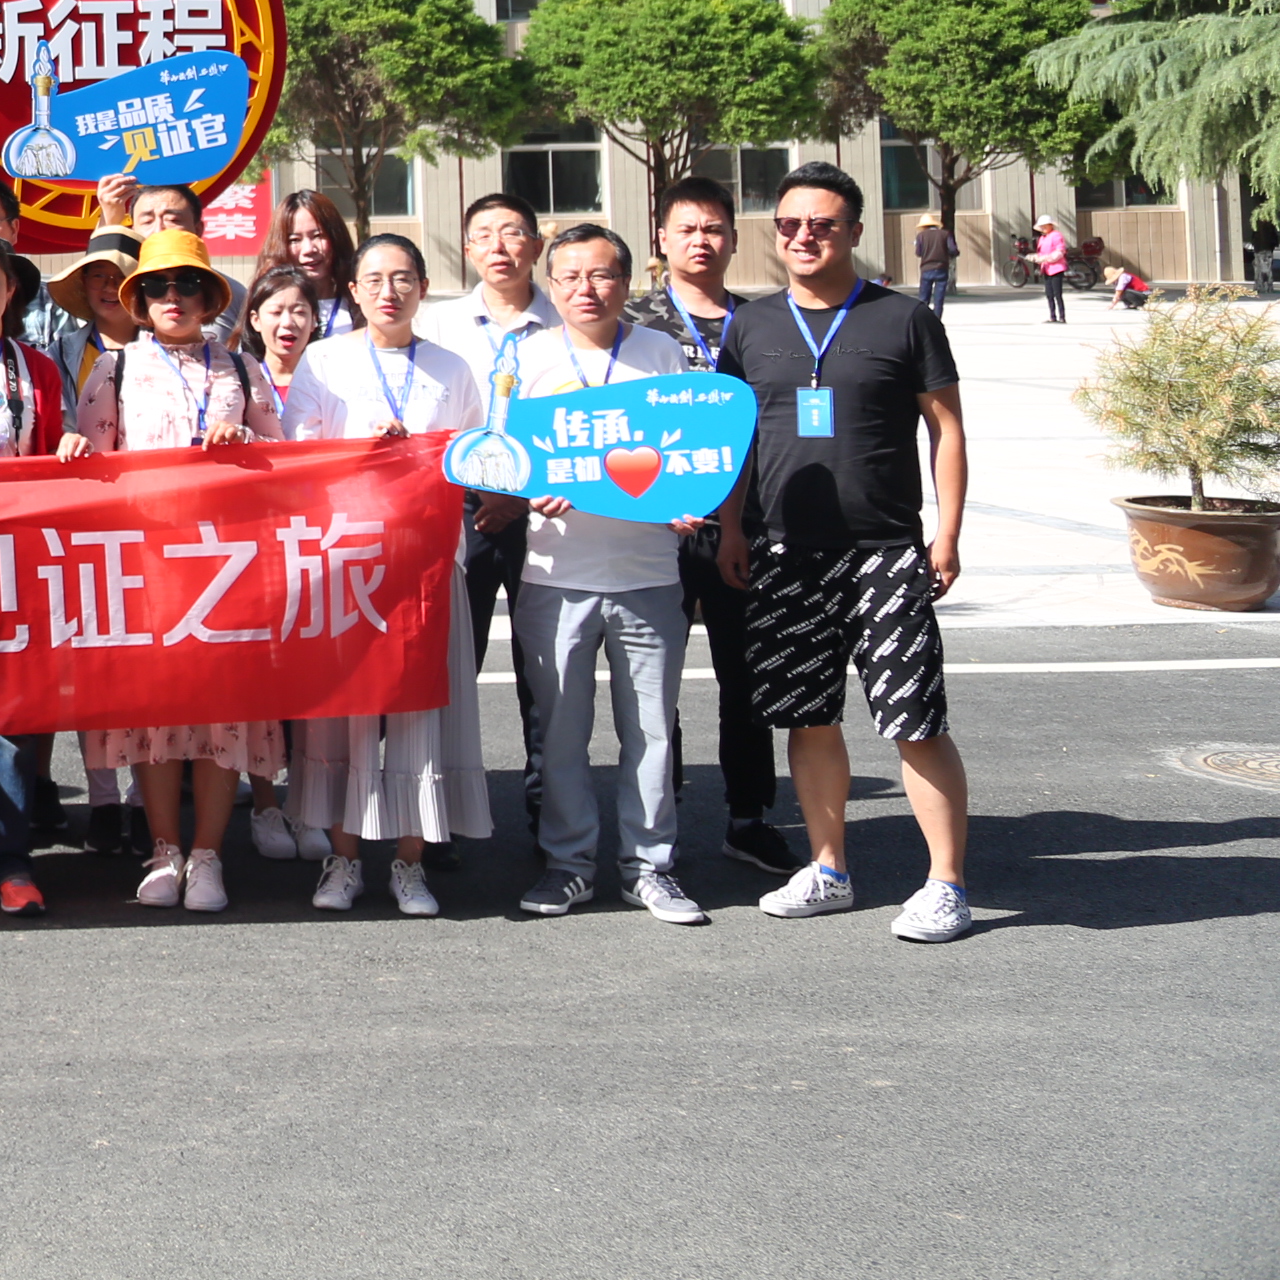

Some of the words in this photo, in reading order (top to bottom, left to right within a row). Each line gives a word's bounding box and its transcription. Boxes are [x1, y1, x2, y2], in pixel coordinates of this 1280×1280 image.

[75, 92, 175, 137] 我是品质
[122, 113, 228, 174] 见证官
